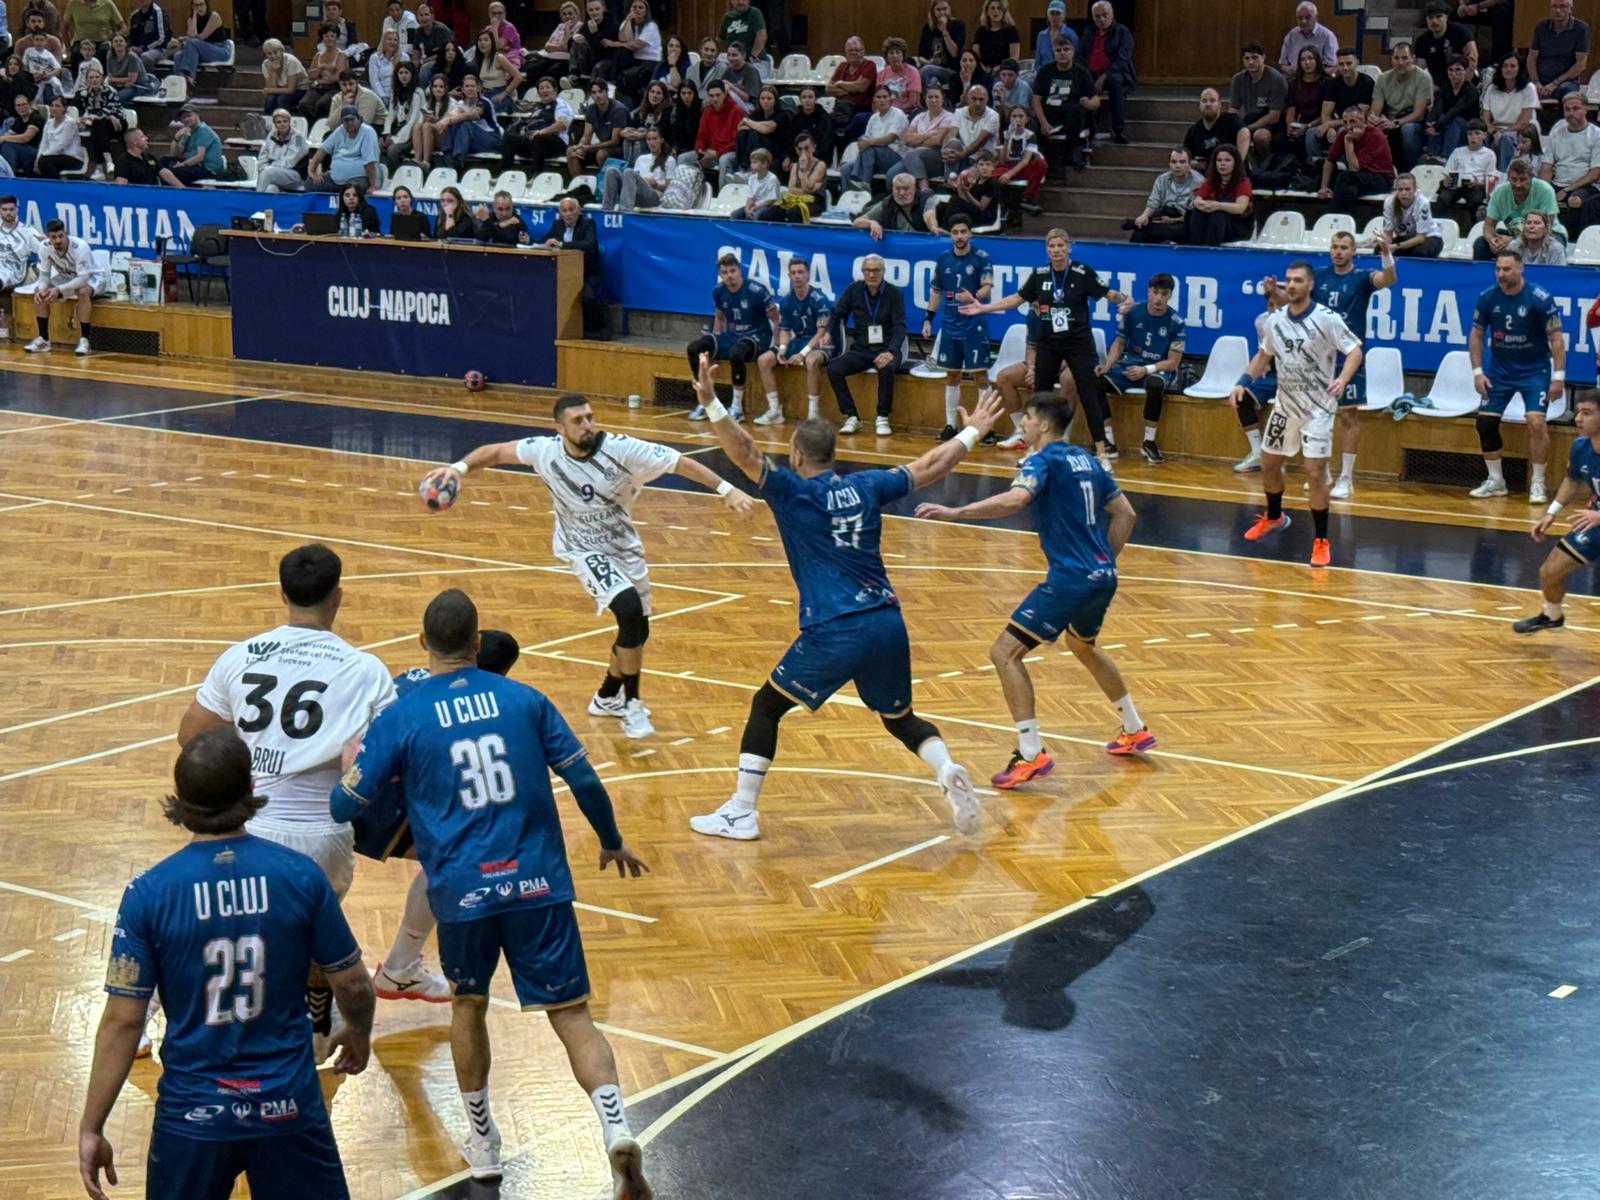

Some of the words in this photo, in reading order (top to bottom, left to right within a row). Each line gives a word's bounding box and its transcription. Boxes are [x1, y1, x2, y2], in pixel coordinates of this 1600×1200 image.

[1505, 314, 1513, 330] 2
[1145, 332, 1152, 347] 5
[1285, 339, 1304, 353] 97
[1346, 383, 1358, 400] 21
[1539, 391, 1547, 407] 2
[581, 484, 595, 502] 9
[238, 672, 329, 740] 36
[434, 700, 453, 728] U
[454, 691, 500, 724] CLUJ
[450, 733, 516, 811] 36
[519, 876, 550, 893] PMA
[193, 881, 211, 920] U
[217, 876, 269, 917] CLUJ
[203, 933, 267, 1025] 23
[261, 1098, 298, 1116] PMA
